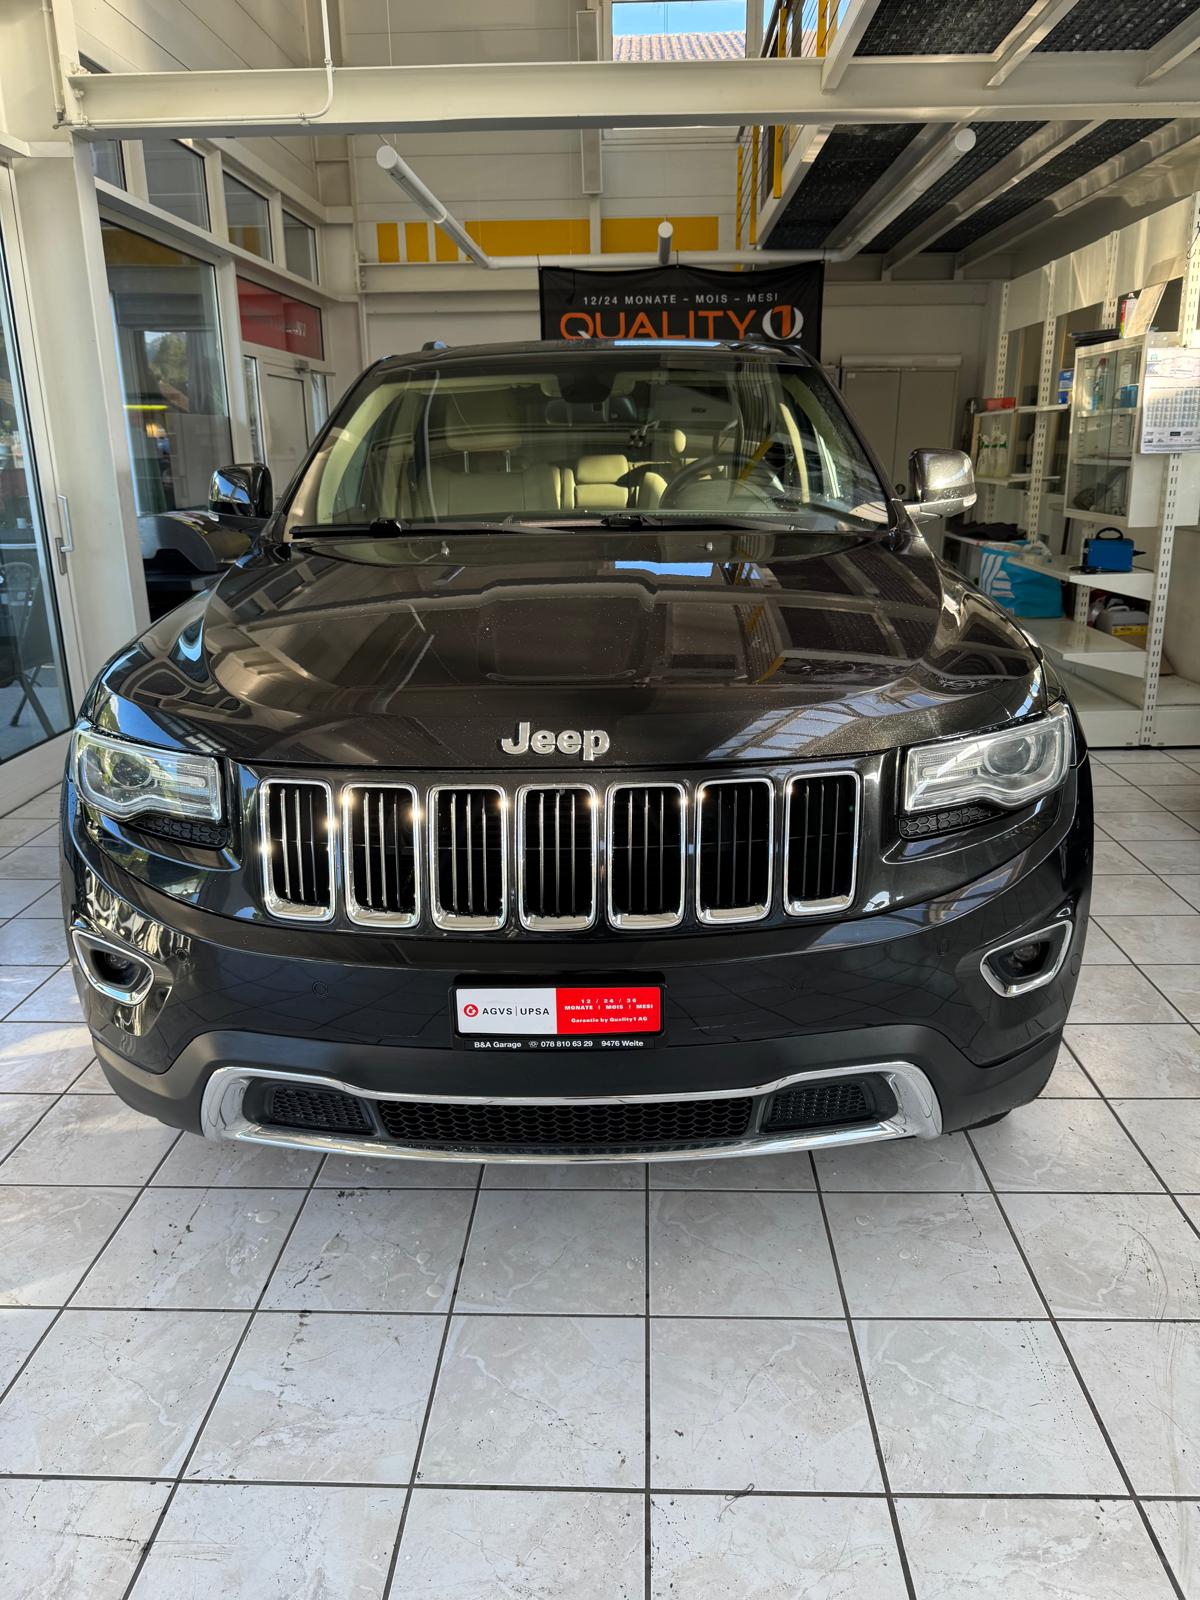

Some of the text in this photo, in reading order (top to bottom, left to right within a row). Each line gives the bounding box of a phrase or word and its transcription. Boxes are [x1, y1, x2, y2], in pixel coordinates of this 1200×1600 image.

[583, 296, 618, 306] 12/24
[625, 295, 677, 305] MONATE
[696, 294, 728, 304] MOIS
[747, 292, 779, 303] MESI
[560, 309, 757, 340] QUALITY
[501, 721, 610, 761] Jeep
[482, 1007, 550, 1015] AGVS UPSA
[493, 1041, 522, 1049] Garage
